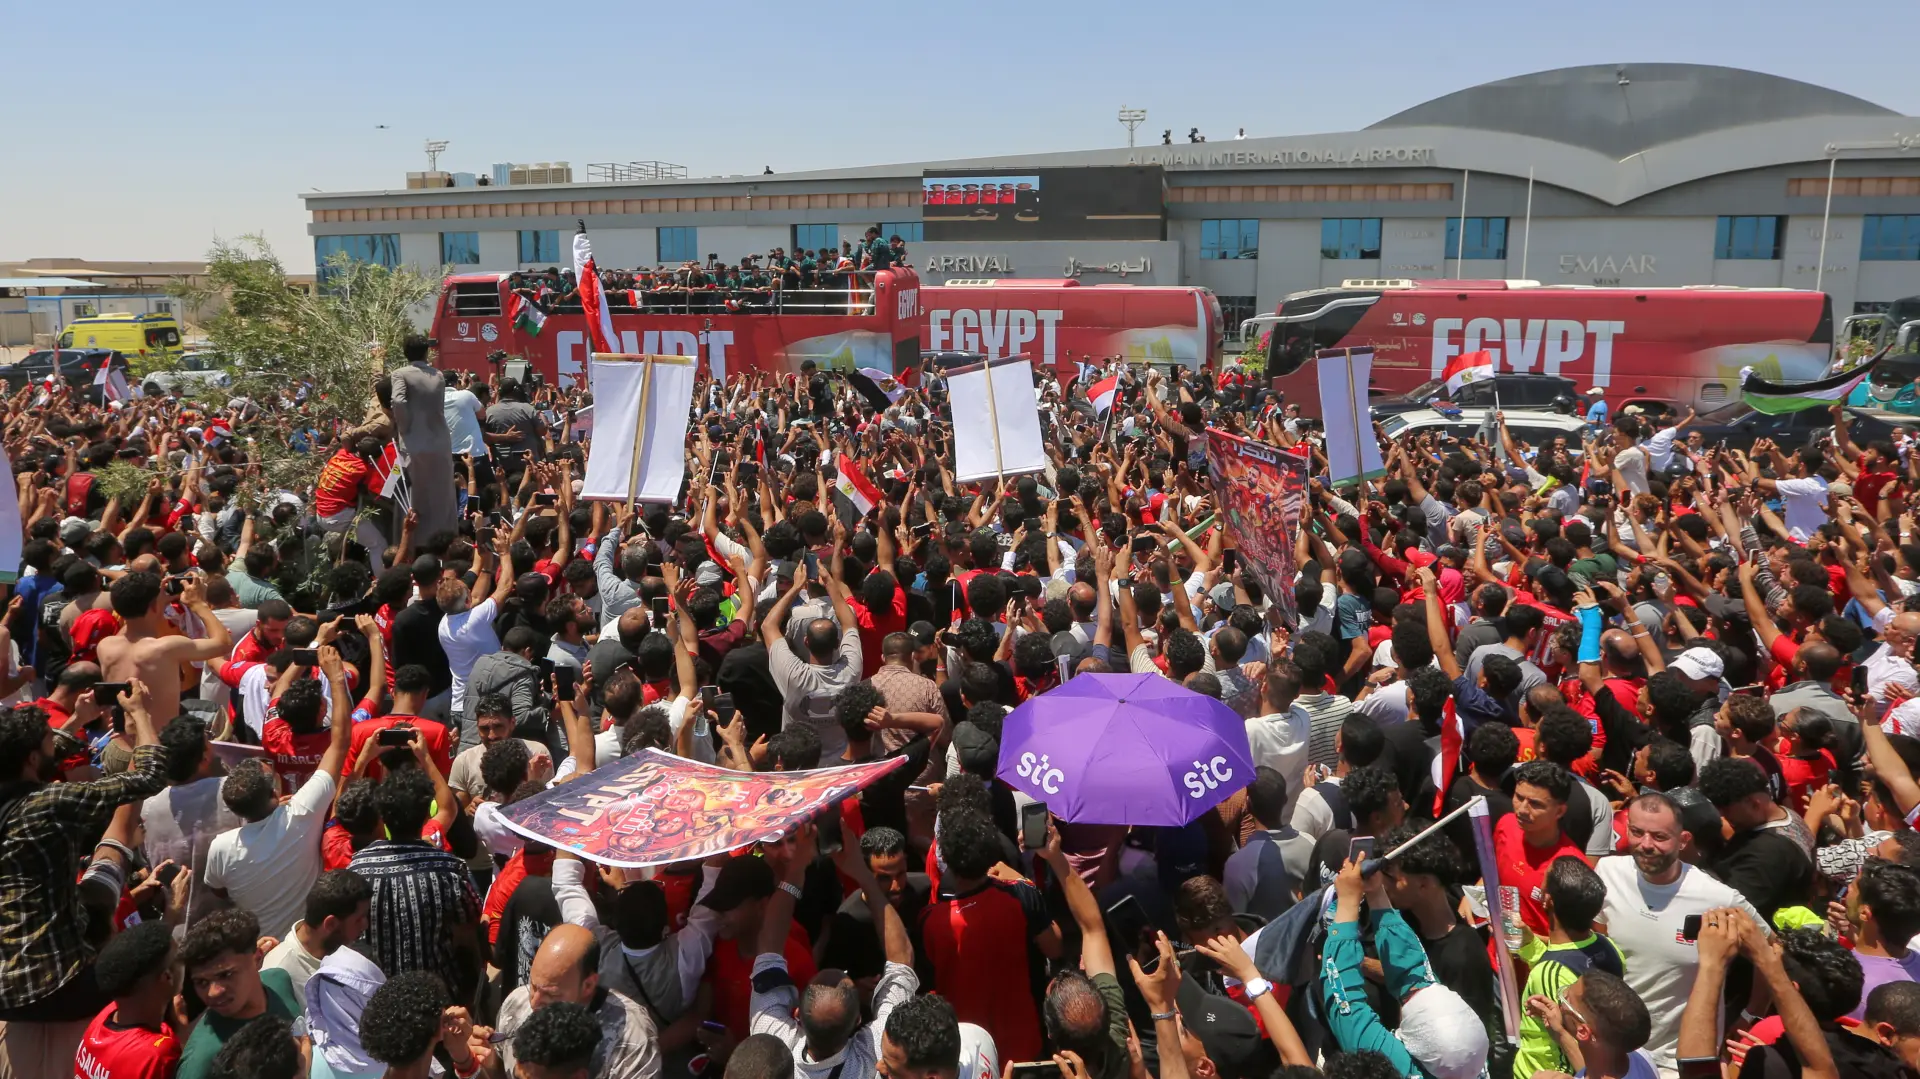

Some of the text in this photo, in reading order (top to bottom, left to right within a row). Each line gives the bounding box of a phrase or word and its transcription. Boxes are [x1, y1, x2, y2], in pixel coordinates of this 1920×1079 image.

[1208, 148, 1347, 165] INTERNATIONAL
[1351, 146, 1436, 162] AIRPORT
[926, 255, 1016, 273] ARRIVAL
[1558, 254, 1657, 274] EMAAR
[898, 288, 918, 320] EGYPT
[1016, 751, 1065, 795] stc
[1183, 755, 1233, 799] stc
